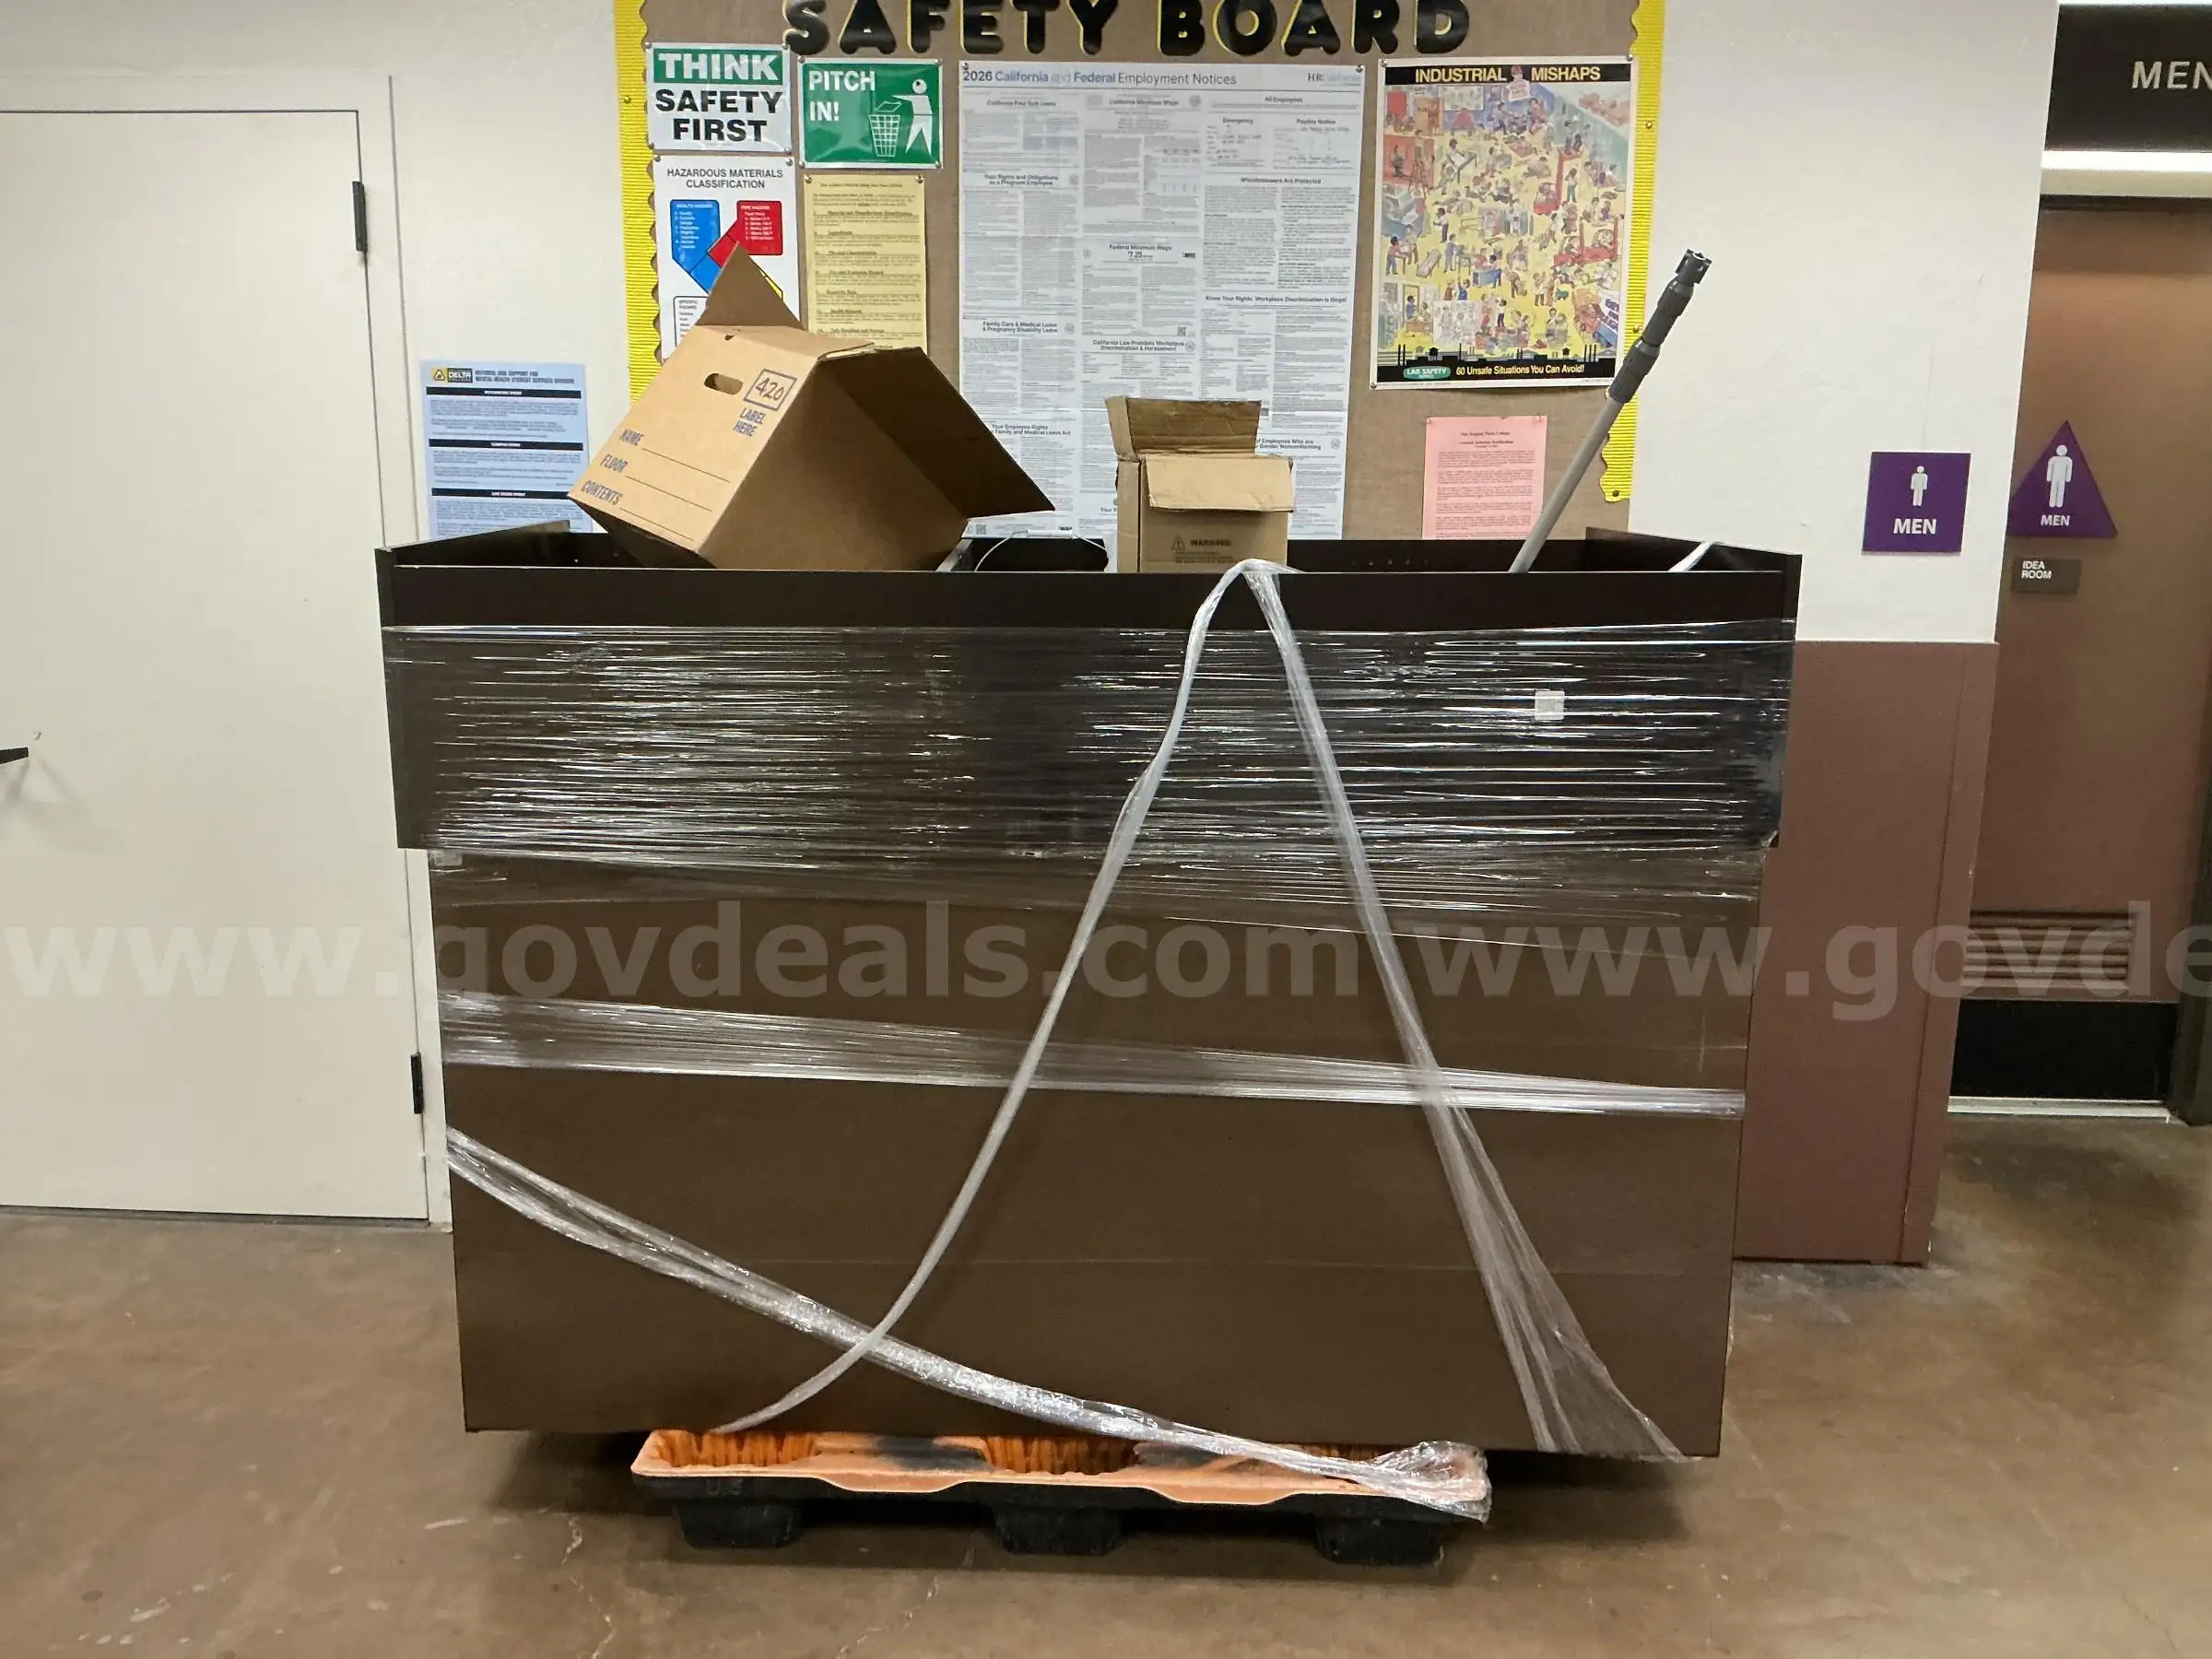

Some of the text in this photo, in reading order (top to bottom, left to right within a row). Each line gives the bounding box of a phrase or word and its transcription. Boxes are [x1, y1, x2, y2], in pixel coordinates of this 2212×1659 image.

[783, 0, 1470, 55] SAFETY BOARD
[659, 53, 779, 81] THINK
[1416, 66, 1601, 83] INDUSTRIAL MISHAPS
[808, 70, 876, 92] PITCH
[963, 71, 993, 82] 2026
[995, 71, 1049, 83] California
[1074, 72, 1116, 83] Federal
[1118, 73, 1189, 88] Employment
[1193, 74, 1237, 85] Notices
[655, 88, 782, 114] SAFETY
[810, 101, 840, 122] IN!
[673, 118, 767, 142] FIRST
[667, 169, 783, 179] HAZARDOUS MATERIALS
[686, 179, 765, 189] CLASSIFICATION
[448, 371, 472, 379] DELTA
[1455, 364, 1585, 376] 60 Unsafe Situations You Can Avoid!
[754, 377, 785, 402] 420
[739, 407, 766, 425] LABEL
[619, 429, 644, 446] NAME
[733, 421, 758, 437] HERE
[600, 454, 628, 473] FLOOR
[581, 480, 623, 506] CONTENTS
[1893, 518, 1937, 535] MEN
[2041, 514, 2071, 526] MEN
[2022, 560, 2045, 570] IDEA
[2021, 570, 2052, 579] ROOM
